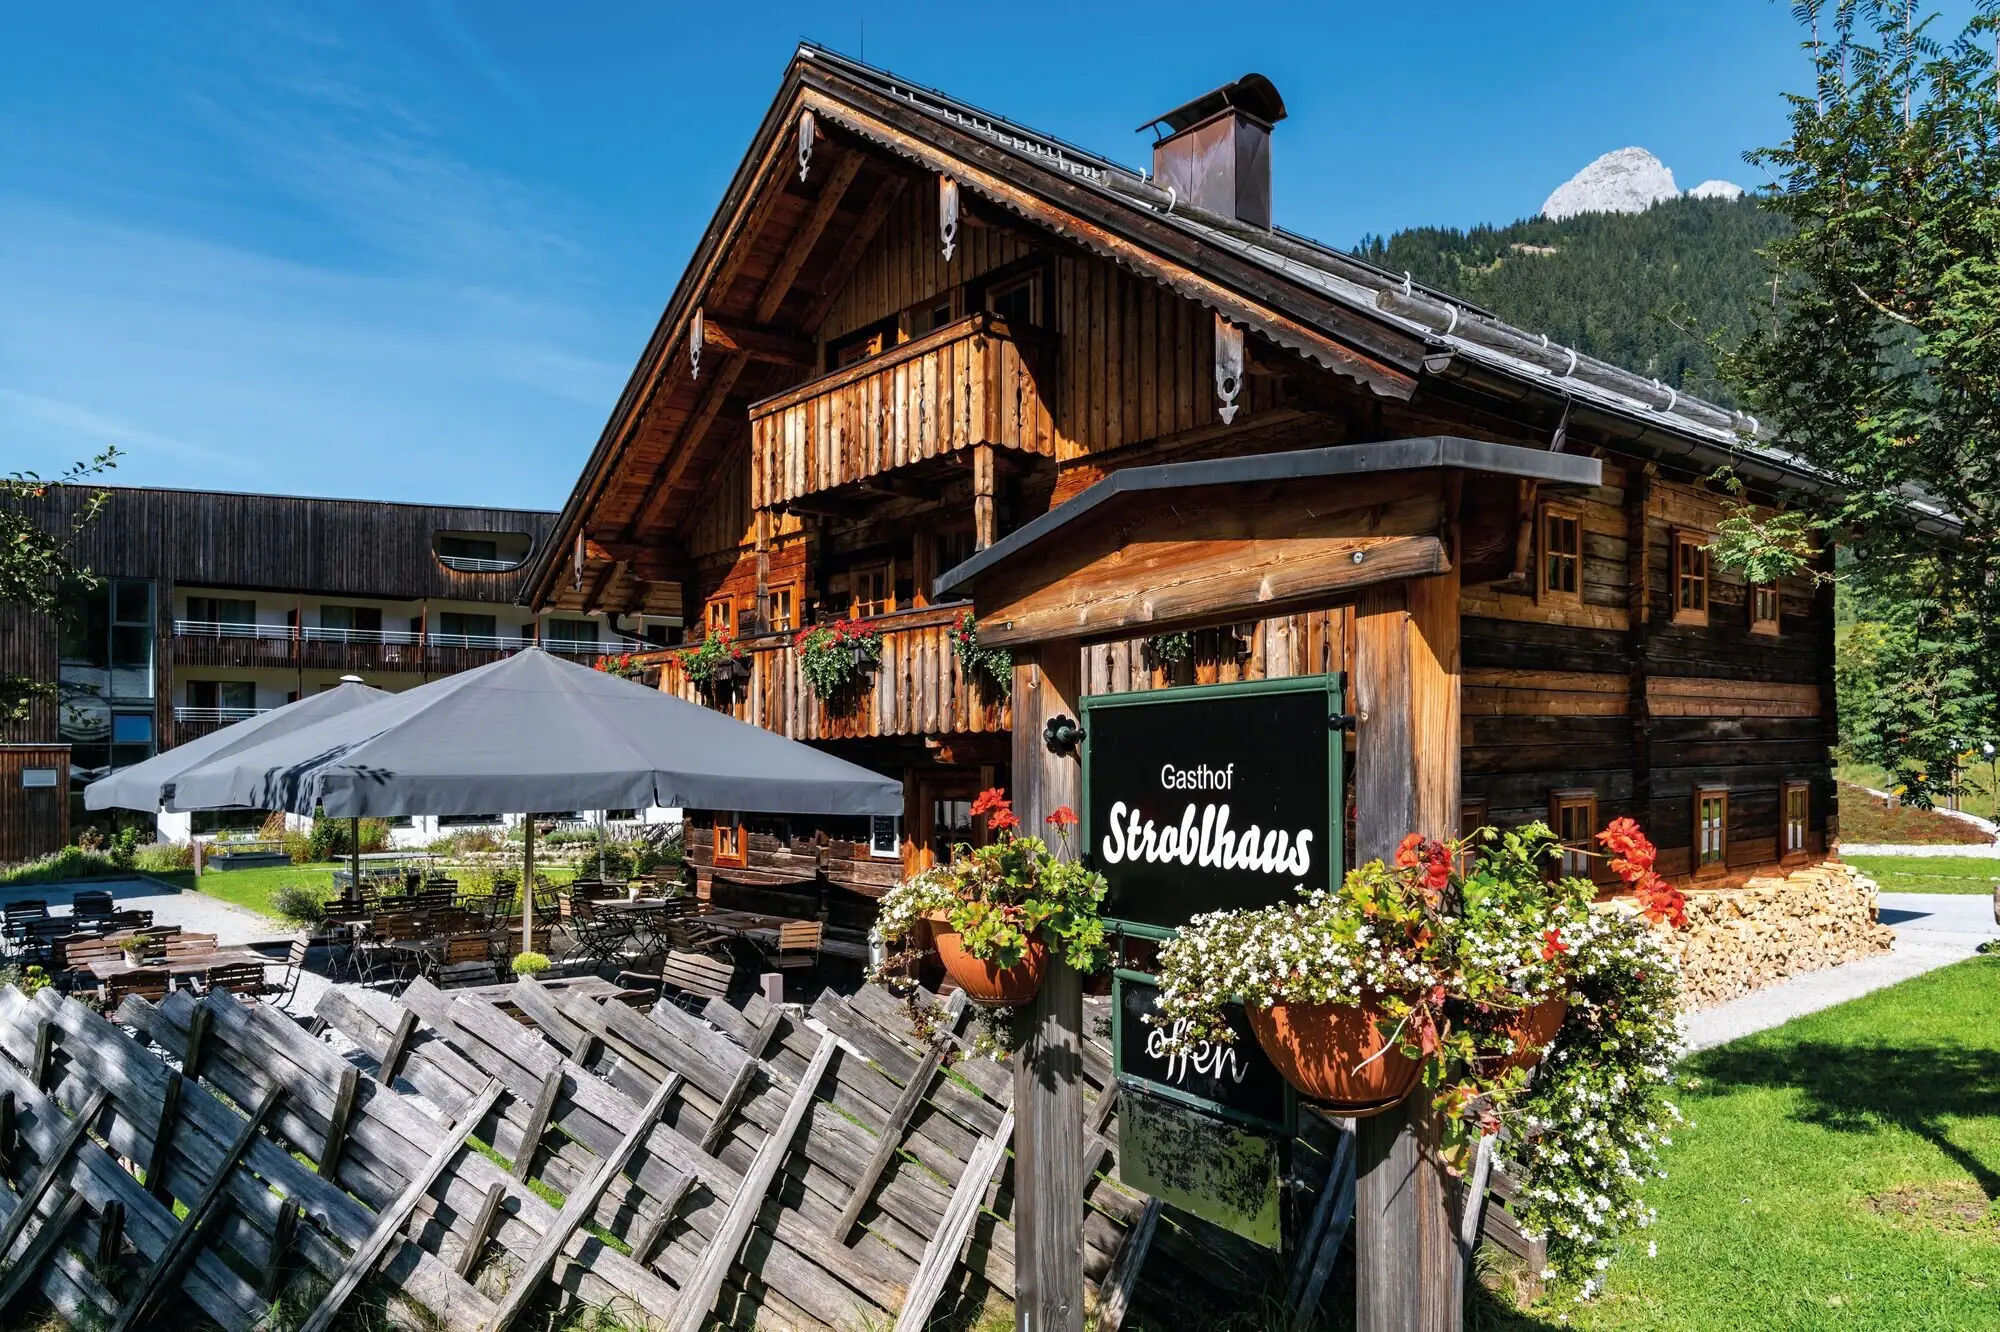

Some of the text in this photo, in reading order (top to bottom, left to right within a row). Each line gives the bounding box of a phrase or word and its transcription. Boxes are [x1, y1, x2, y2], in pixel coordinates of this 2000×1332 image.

[1161, 763, 1234, 790] Gasthof
[1102, 801, 1313, 876] Stroblhaus
[1144, 1016, 1249, 1085] offen
